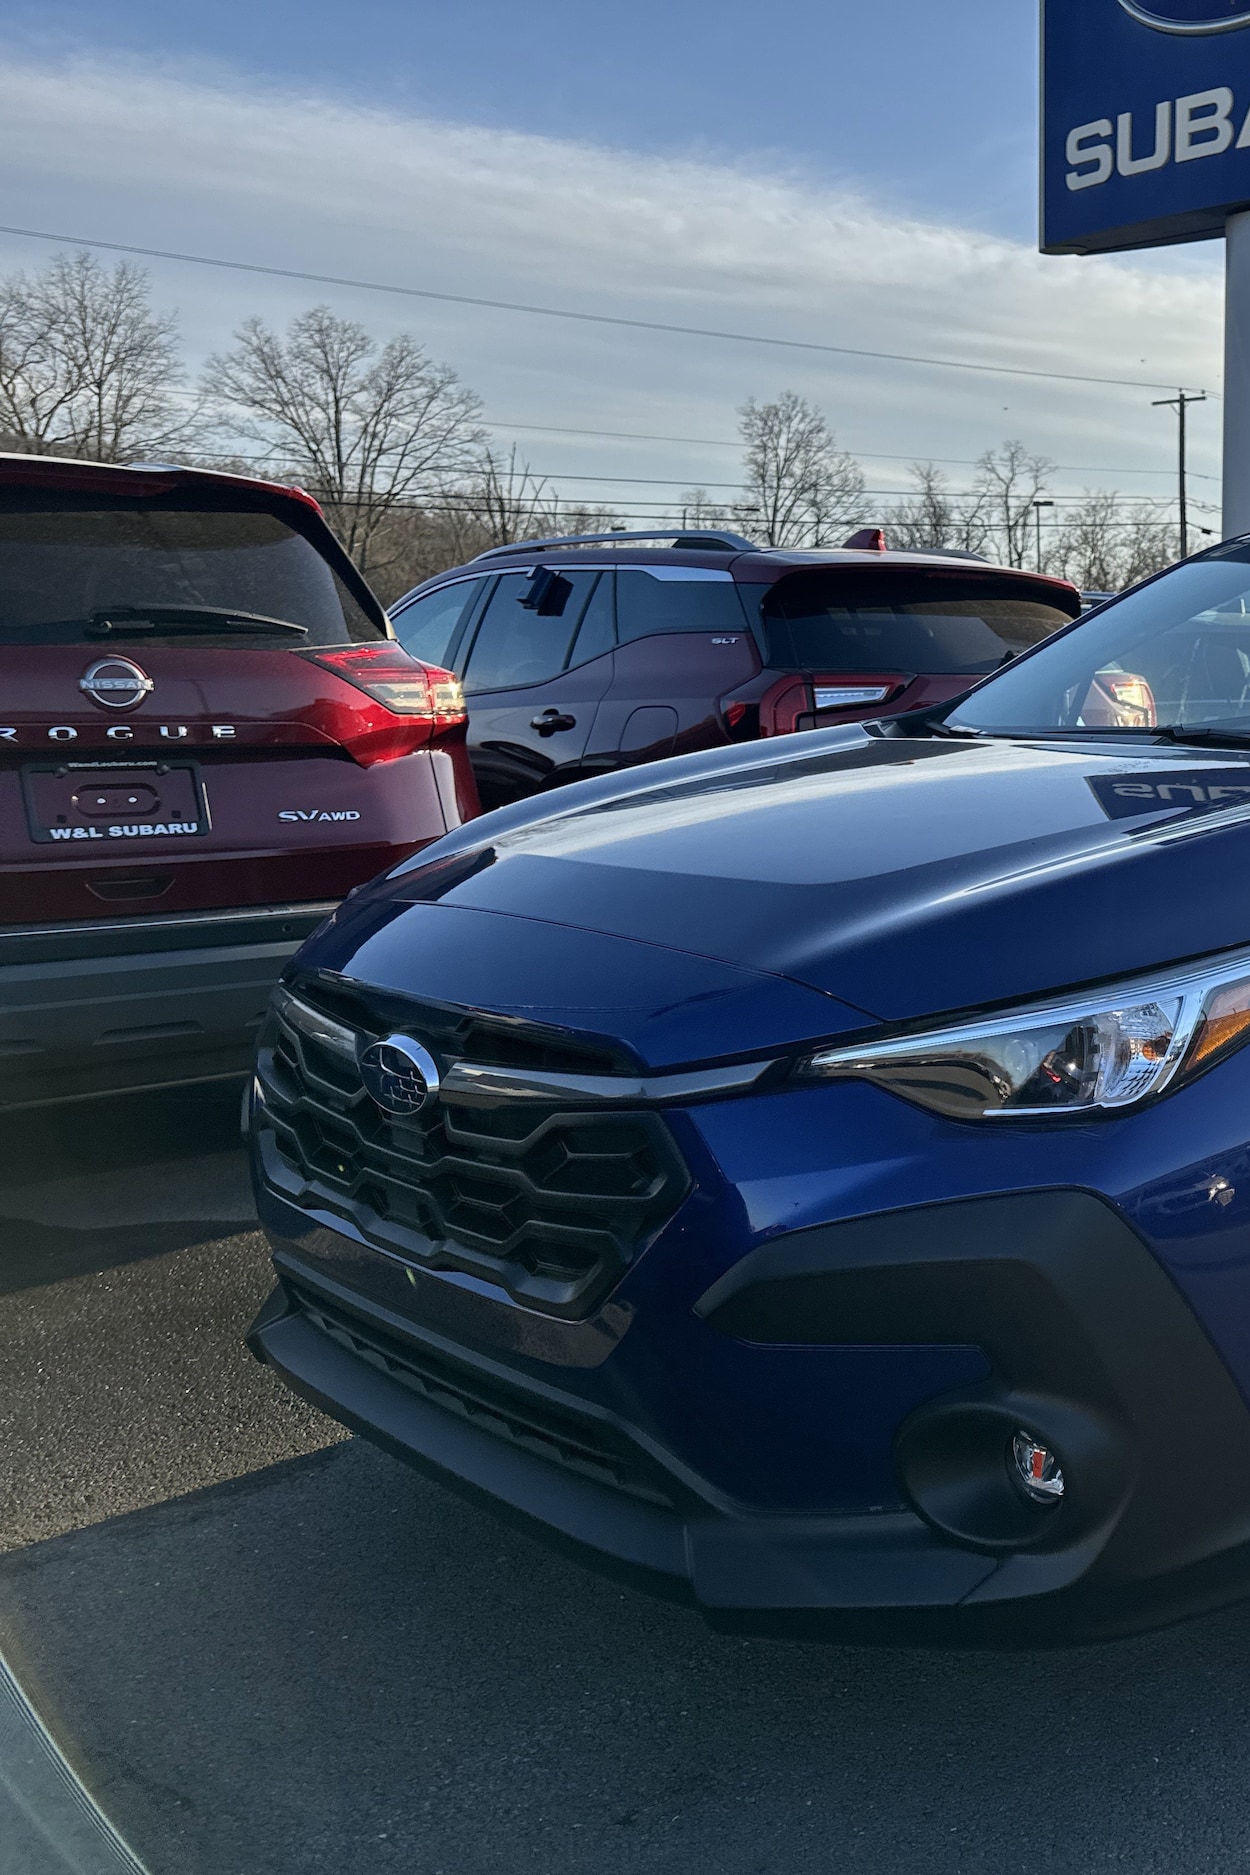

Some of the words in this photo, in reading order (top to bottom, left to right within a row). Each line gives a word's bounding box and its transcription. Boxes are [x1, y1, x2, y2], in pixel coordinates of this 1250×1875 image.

[82, 680, 149, 689] NISSAN
[0, 725, 237, 743] ROGUE
[278, 809, 319, 822] SV
[318, 810, 361, 821] AWD
[50, 826, 104, 840] W&L
[108, 822, 198, 838] SUBARU
